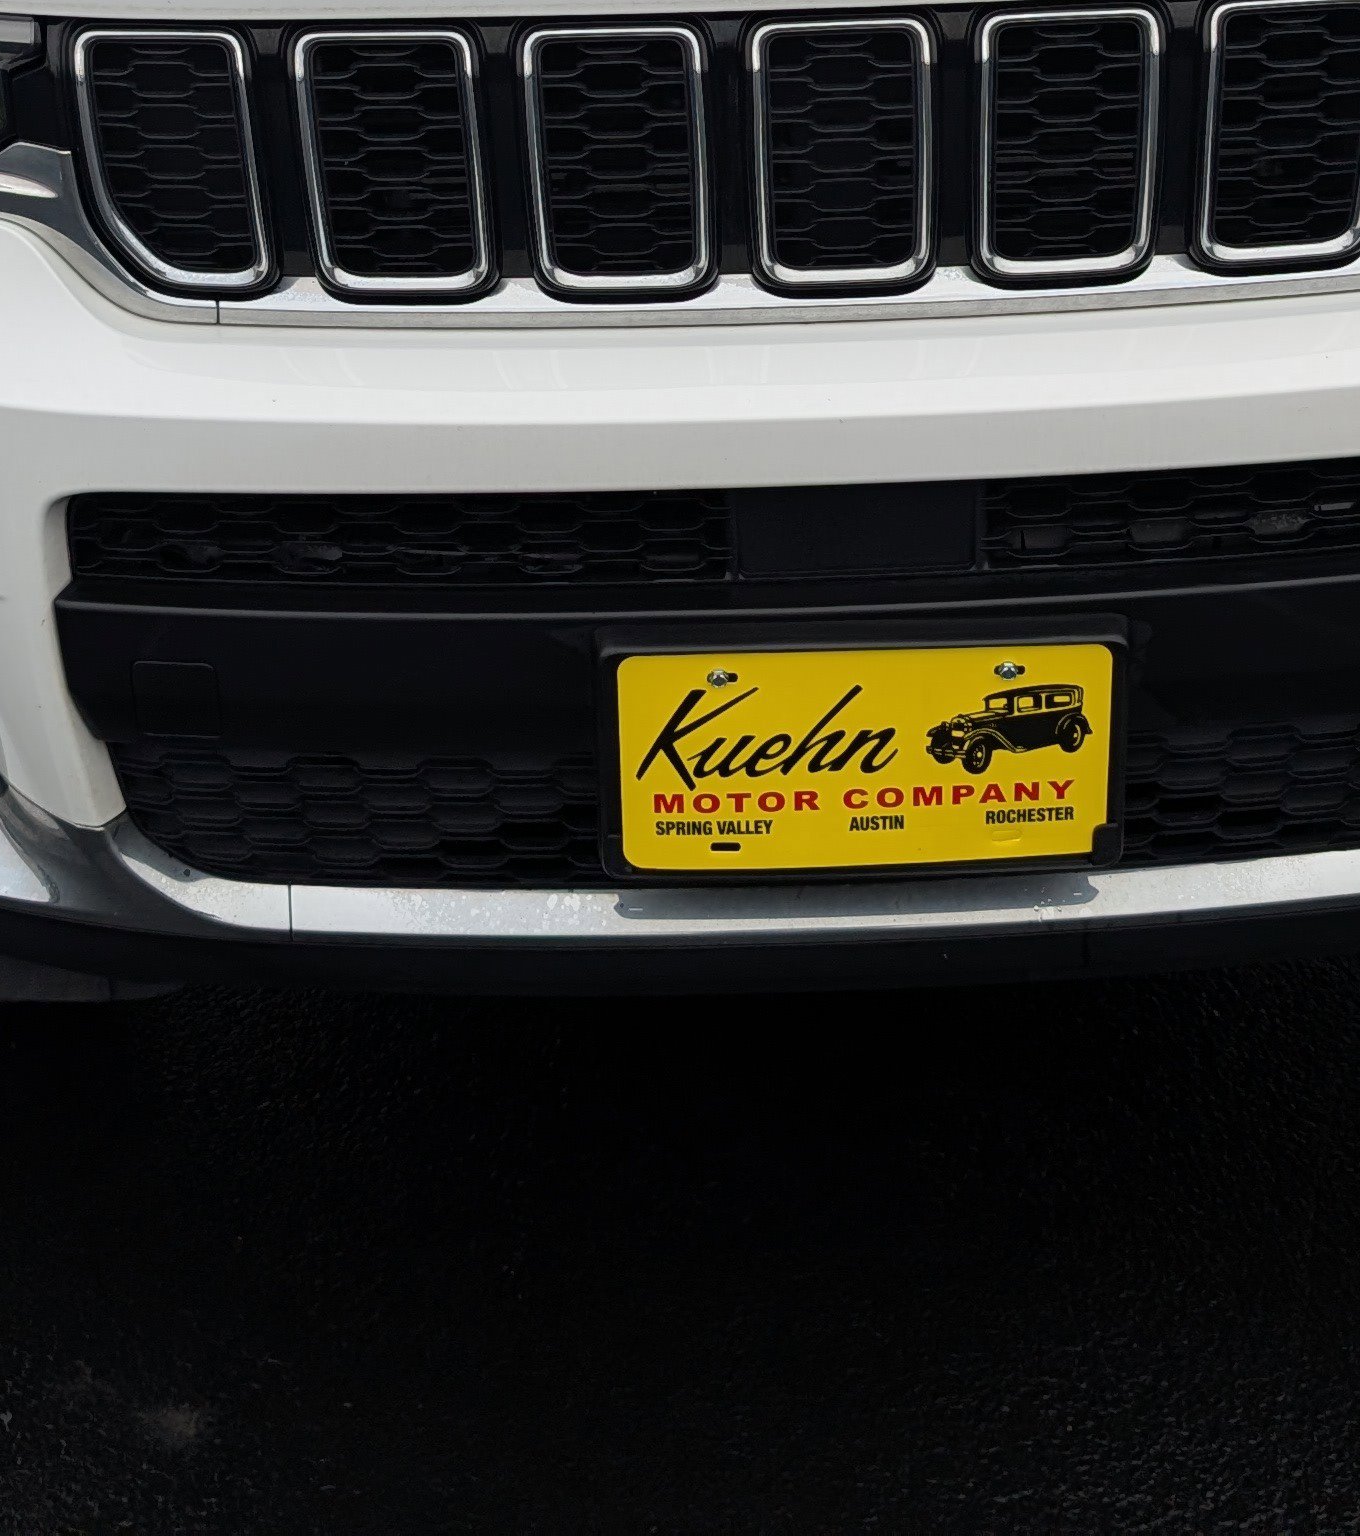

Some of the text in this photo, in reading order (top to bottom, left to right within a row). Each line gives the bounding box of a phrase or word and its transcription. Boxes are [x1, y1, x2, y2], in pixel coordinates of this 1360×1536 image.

[636, 684, 899, 791] Kuehn
[653, 779, 1075, 814] MOTOR COMPANY
[848, 815, 905, 831] AUSTIN
[985, 807, 1075, 825] ROCHESTER
[655, 820, 773, 836] SPRING VALLEY
